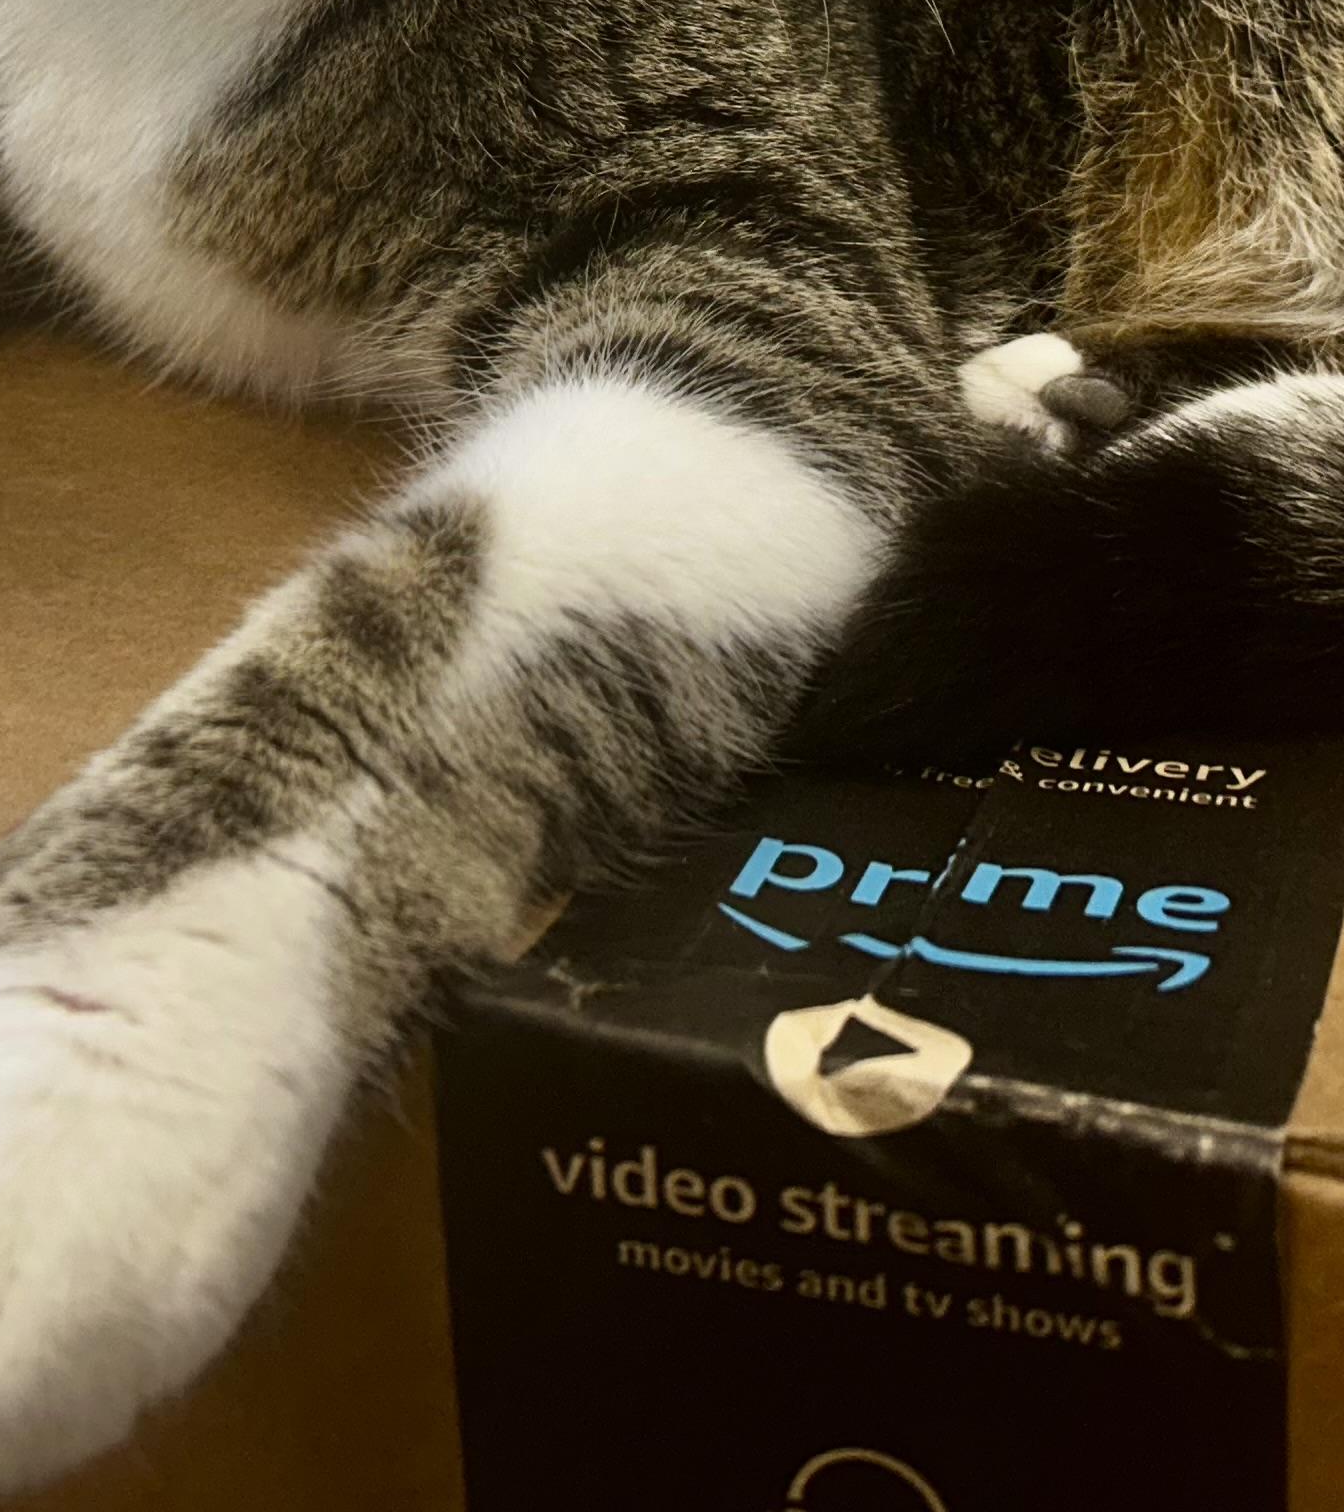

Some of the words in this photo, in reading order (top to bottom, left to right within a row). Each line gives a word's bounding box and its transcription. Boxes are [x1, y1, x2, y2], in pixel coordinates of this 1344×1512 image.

[999, 759, 1024, 783] &
[1037, 777, 1257, 809] convenient
[1011, 740, 1267, 790] elivery
[729, 836, 1231, 932] prme
[542, 1137, 756, 1226] video
[779, 1179, 1197, 1317] streaming
[617, 1236, 784, 1292] movies
[797, 1265, 886, 1311] and
[903, 1285, 953, 1320] tv
[965, 1296, 1124, 1351] shows
